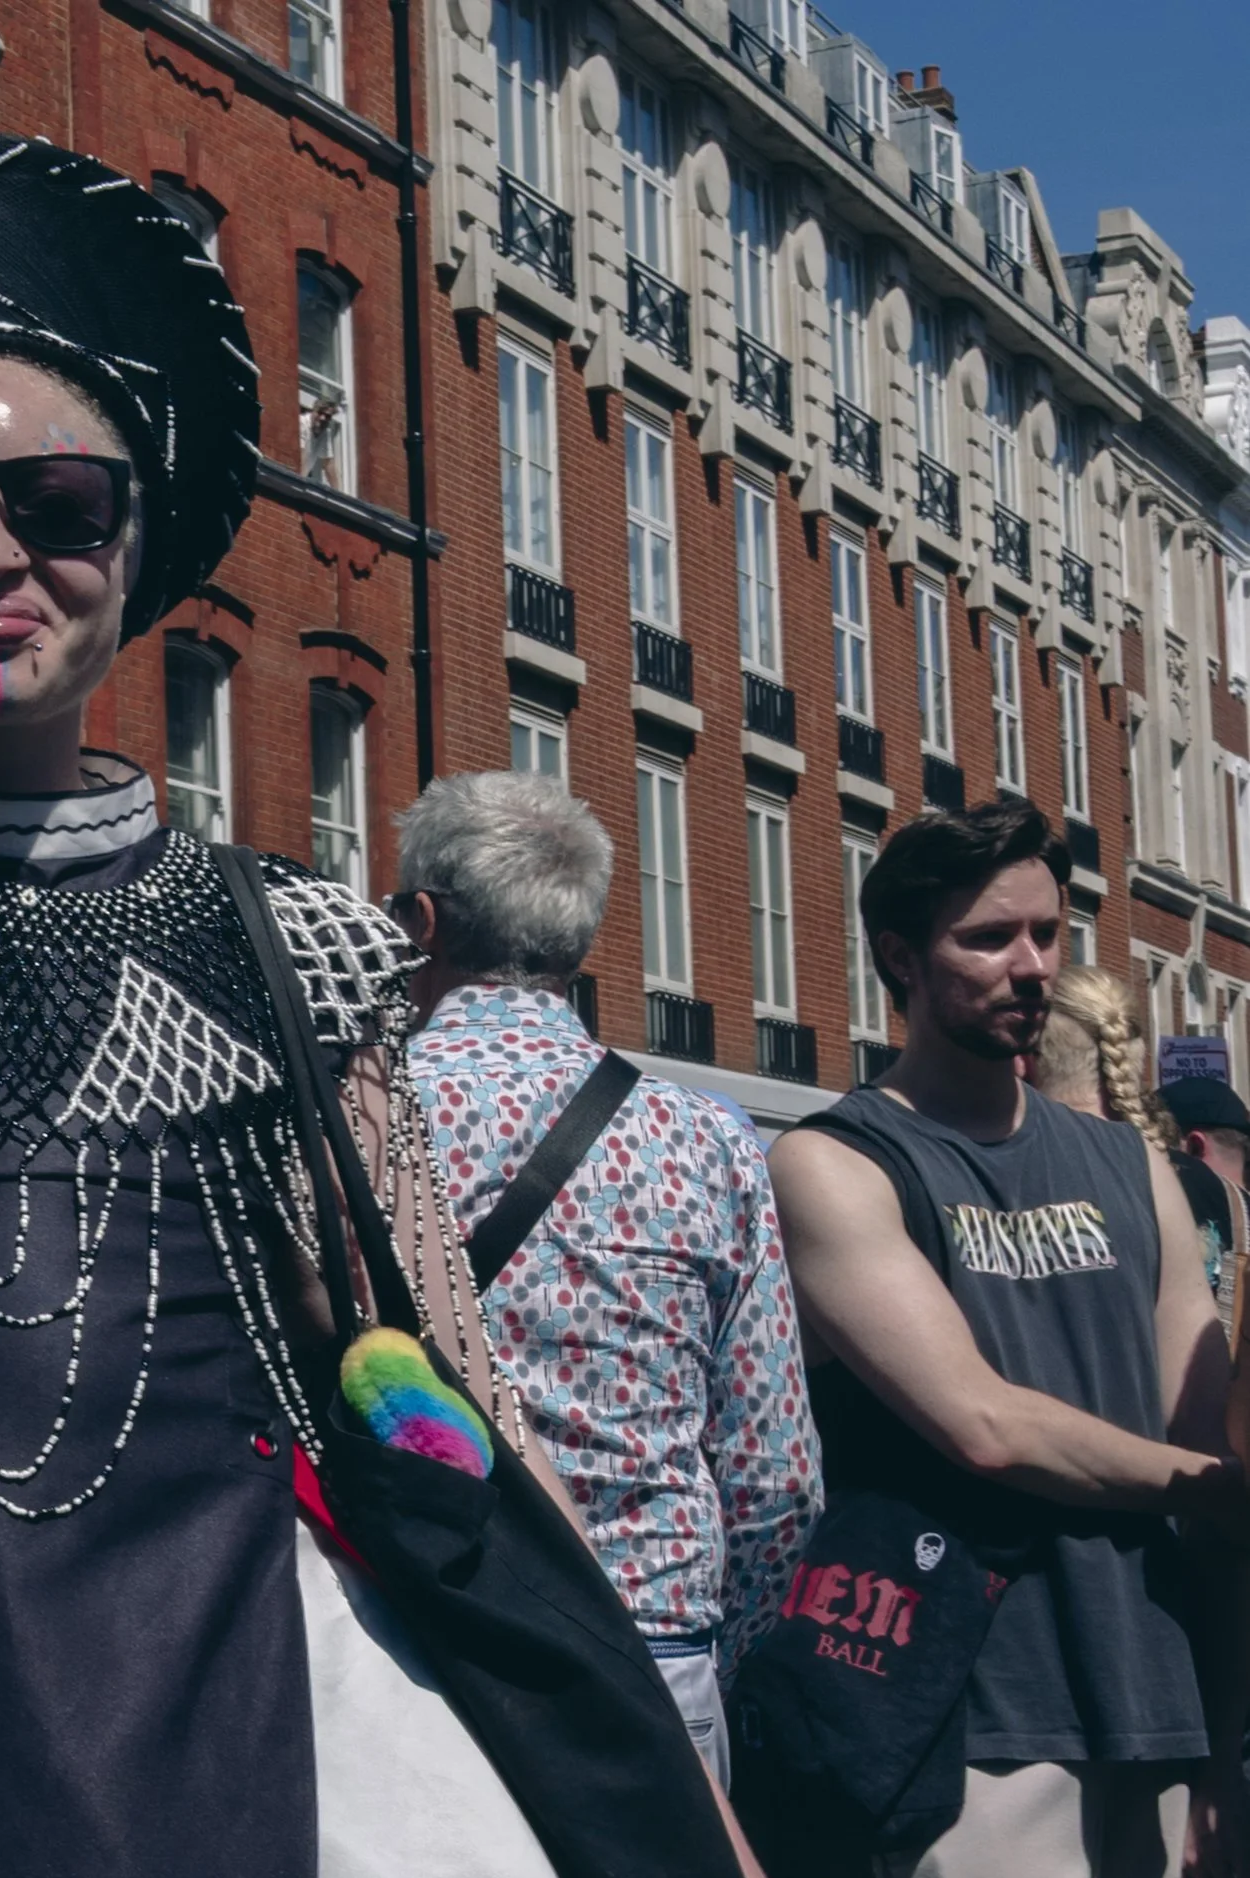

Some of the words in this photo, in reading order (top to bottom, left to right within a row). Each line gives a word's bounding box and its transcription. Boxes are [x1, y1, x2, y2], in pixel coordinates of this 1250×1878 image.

[1176, 1057, 1191, 1068] NO
[1193, 1056, 1207, 1068] TO
[814, 1633, 888, 1677] BALL
